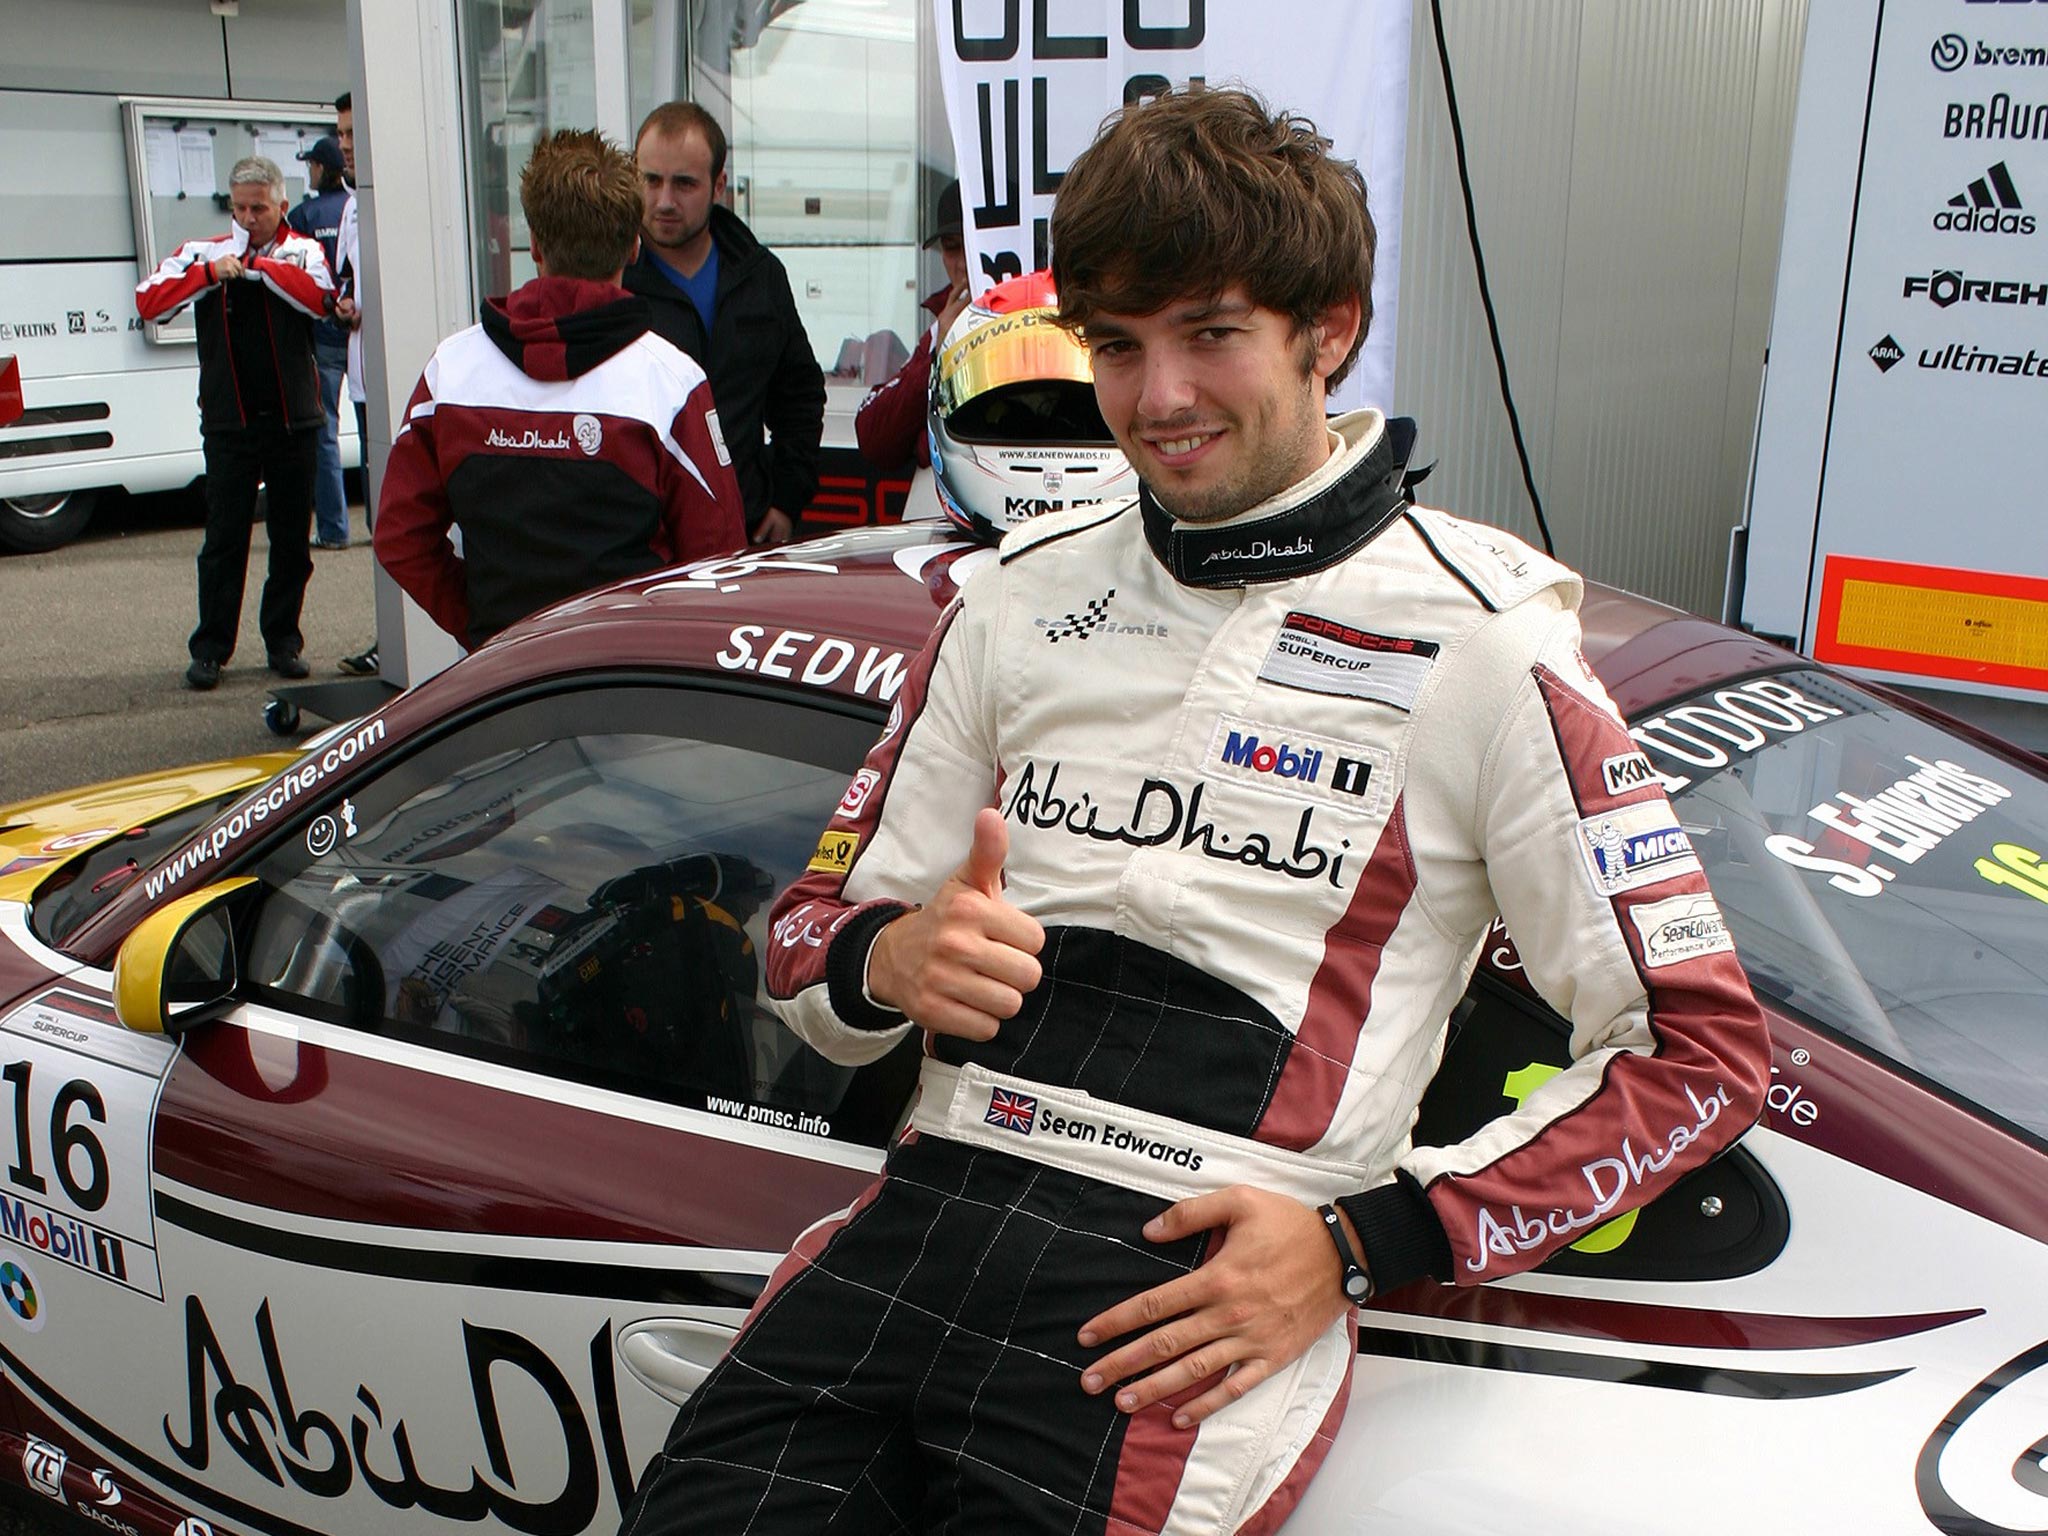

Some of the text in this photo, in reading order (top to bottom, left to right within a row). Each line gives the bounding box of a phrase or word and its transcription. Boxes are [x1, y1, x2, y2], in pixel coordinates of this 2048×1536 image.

[1974, 41, 2048, 66] brem
[1933, 207, 2037, 235] adidas
[13, 323, 57, 338] VELTINS
[1871, 346, 1901, 360] ARAL
[999, 451, 1111, 460] WWW.SEANEDWARDS.EU
[1287, 614, 1415, 652] PORSCHE
[1277, 642, 1372, 671] SUPERCUP
[1628, 681, 1844, 794] UDOR
[1221, 731, 1323, 783] Mobil
[145, 718, 387, 900] www.porsche.com
[1807, 754, 2013, 865] Edwards
[1635, 832, 1692, 862] MICH
[32, 1020, 89, 1043] SUPERCUP
[706, 1095, 831, 1136] www.pmsc.info
[3, 1060, 110, 1212] 16
[1039, 1109, 1204, 1172] Sean Edwards
[0, 1195, 90, 1268] Mobil
[77, 1501, 140, 1536] SACHS
